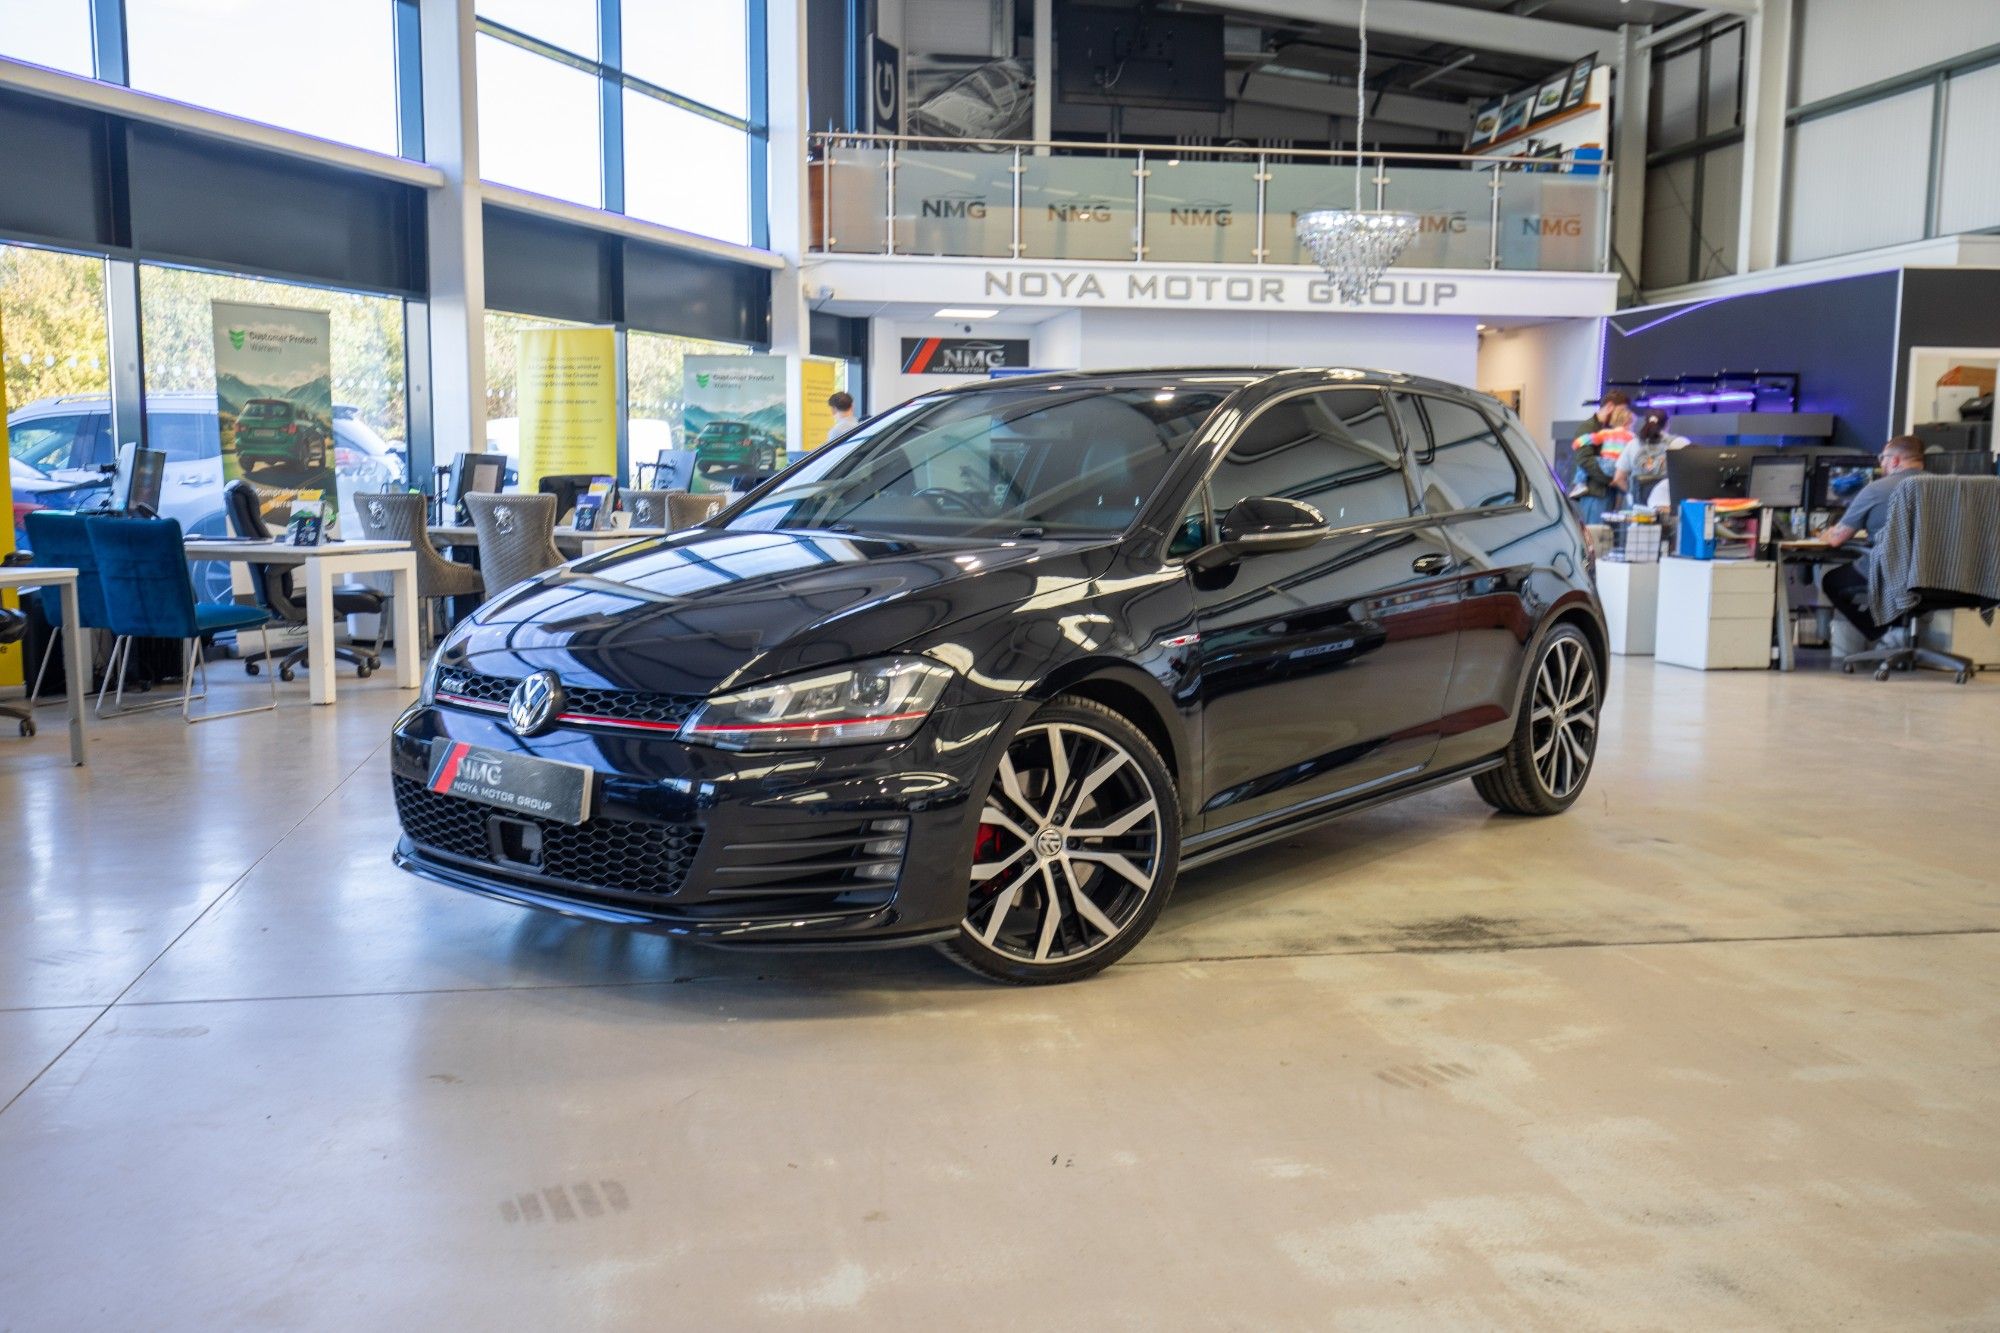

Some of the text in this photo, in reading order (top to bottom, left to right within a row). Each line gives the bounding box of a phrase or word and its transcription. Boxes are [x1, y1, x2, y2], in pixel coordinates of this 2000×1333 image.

[921, 199, 987, 218] NMG
[1047, 203, 1112, 222] NMG
[1170, 207, 1233, 226] NMG
[1522, 217, 1581, 236] NMG
[985, 271, 1105, 299] NOYA
[1128, 273, 1285, 303] MOTOR
[943, 349, 1006, 368] NMG
[456, 757, 503, 786] NMG
[453, 780, 552, 812] NOYA MOTOR GROUP
